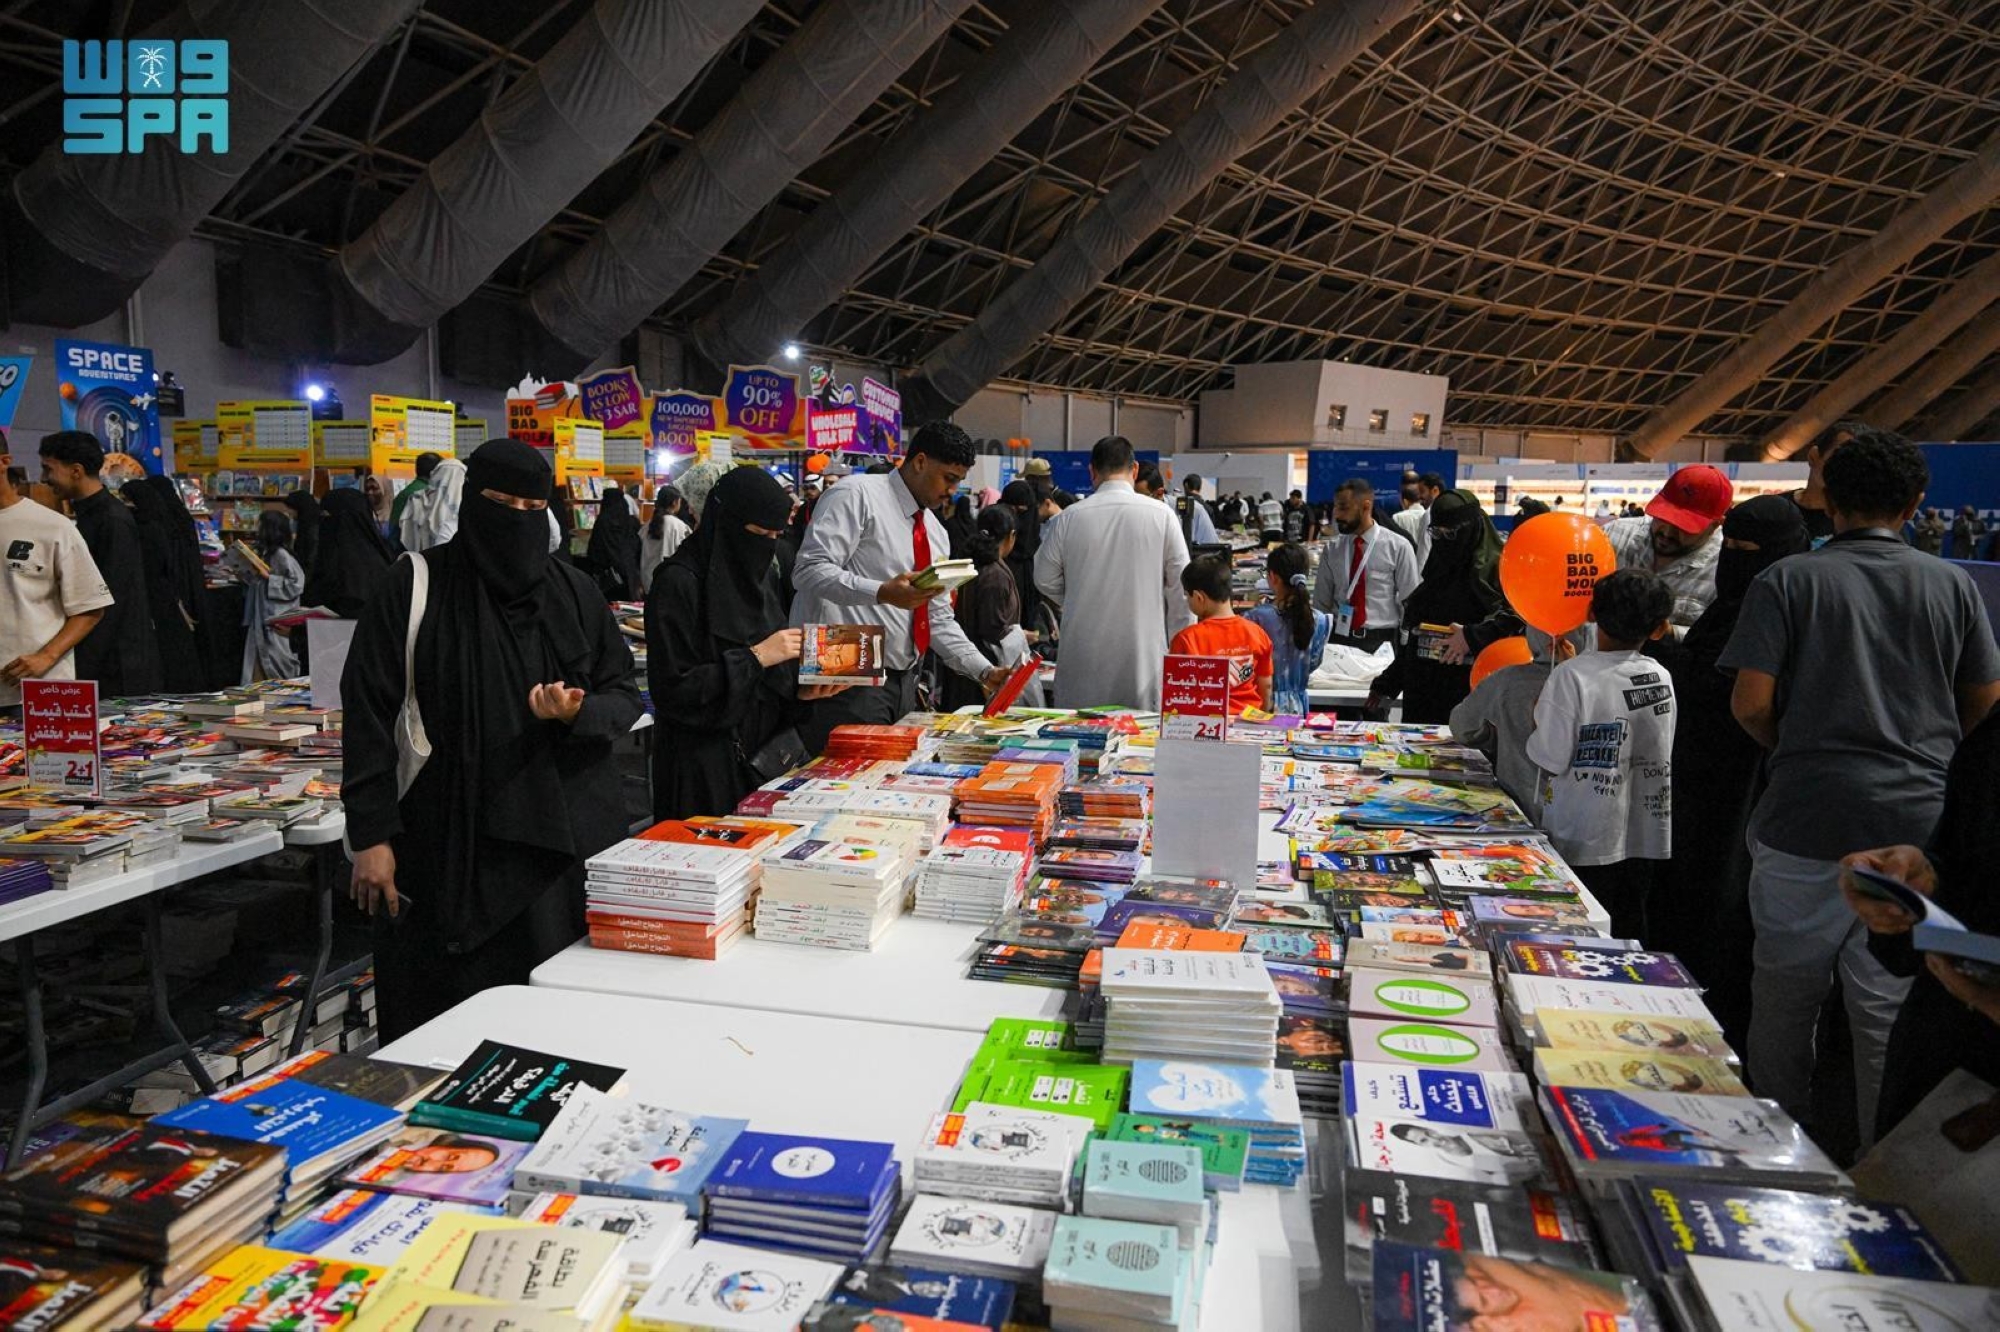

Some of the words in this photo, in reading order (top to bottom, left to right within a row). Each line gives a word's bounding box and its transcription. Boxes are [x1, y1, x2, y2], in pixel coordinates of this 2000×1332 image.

[67, 348, 144, 374] SPACE
[78, 369, 138, 382] ADVENTURES
[749, 374, 764, 385] UP
[765, 377, 779, 388] TO
[587, 378, 629, 398] BOOKS
[742, 385, 782, 408] 90%
[510, 405, 534, 416] BIG
[590, 401, 603, 412] AS
[606, 391, 630, 407] LOW
[615, 402, 637, 416] SAR
[658, 401, 710, 417] 100,000
[511, 418, 538, 430] BAD
[740, 408, 780, 428] OFF
[1568, 554, 1594, 564] BIG
[1568, 566, 1598, 576] BAD
[1567, 578, 1595, 590] WOL
[858, 650, 868, 670] رحلات
[1178, 660, 1197, 668] خاص
[40, 685, 60, 695] خاص
[1166, 672, 1197, 690] قيمة
[1198, 676, 1224, 690] كتب
[61, 685, 81, 696] عرض
[1165, 692, 1196, 706] مخفض
[28, 701, 62, 721] قيمة
[1198, 697, 1224, 710] بسعر
[64, 704, 92, 722] كتب
[29, 725, 64, 742] مخفض
[65, 731, 94, 746] بسعر
[1195, 722, 1221, 738] 2+1
[67, 760, 93, 778] 2+1
[1367, 1080, 1379, 1100] كيف
[1390, 1075, 1420, 1110] تستمع
[1428, 1085, 1441, 1104] حتى
[1441, 1079, 1464, 1114] يتحدث
[1468, 1086, 1484, 1110] الناس
[253, 1097, 325, 1132] التدريب
[1369, 1121, 1385, 1140] صحة
[173, 1156, 241, 1199] التميز
[520, 1239, 557, 1301] الفهرسة
[551, 1246, 581, 1289] بطاقة
